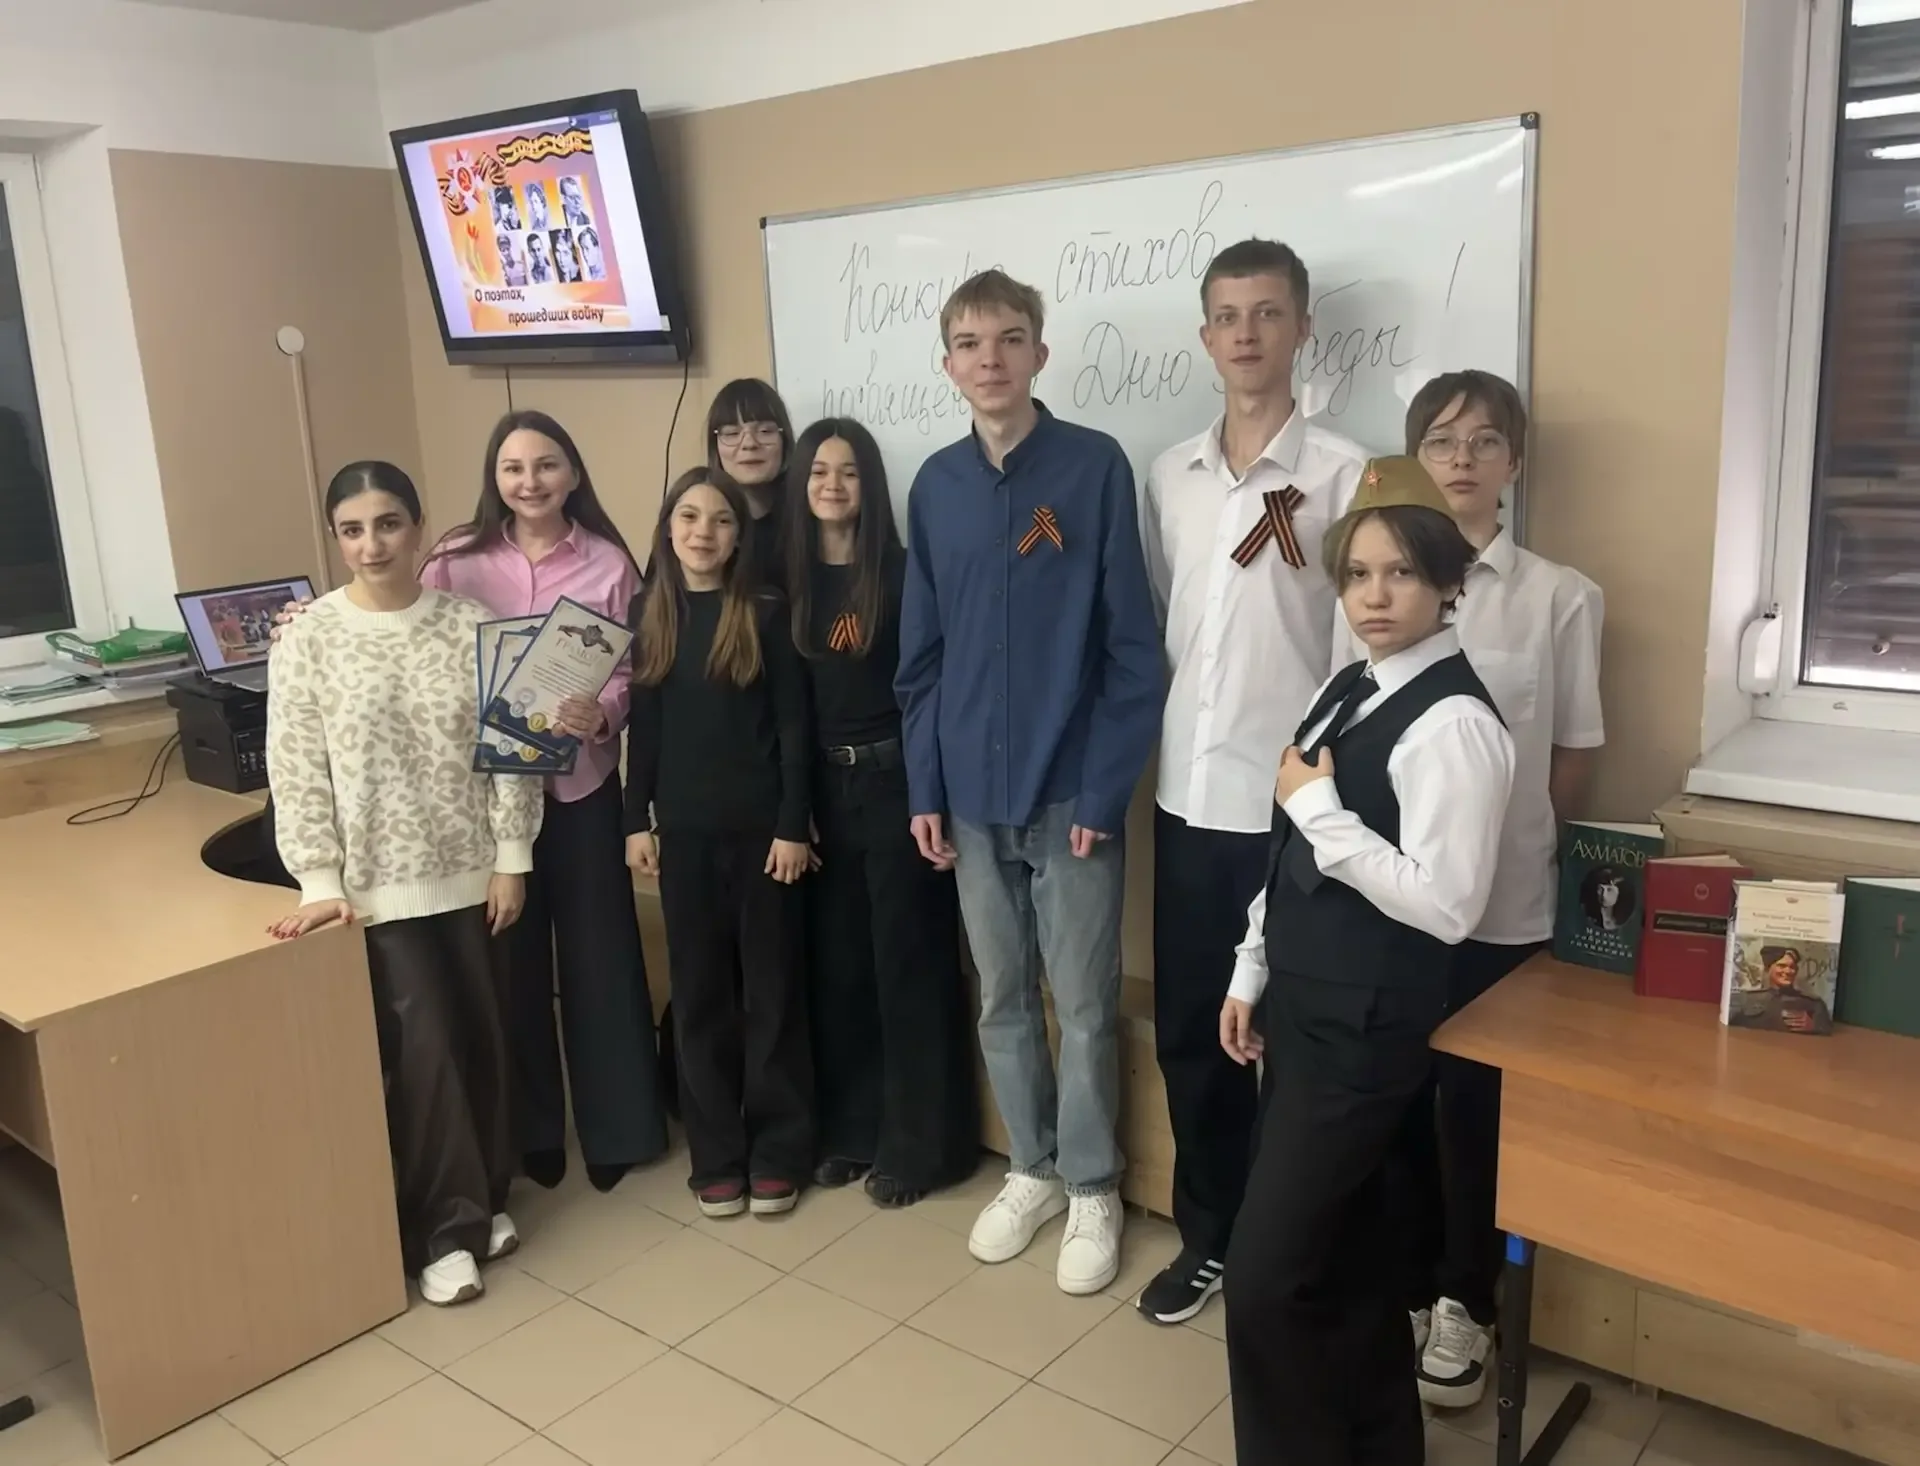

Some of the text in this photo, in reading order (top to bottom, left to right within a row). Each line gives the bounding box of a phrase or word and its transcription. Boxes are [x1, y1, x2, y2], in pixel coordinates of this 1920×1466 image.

[840, 180, 1223, 374] Конку стихов
[474, 288, 525, 302] О поэтах,
[508, 305, 604, 328] прошедших войну
[1073, 321, 1192, 409] Дню
[1213, 278, 1423, 416] беды
[1570, 839, 1646, 868] АХМАТОВ
